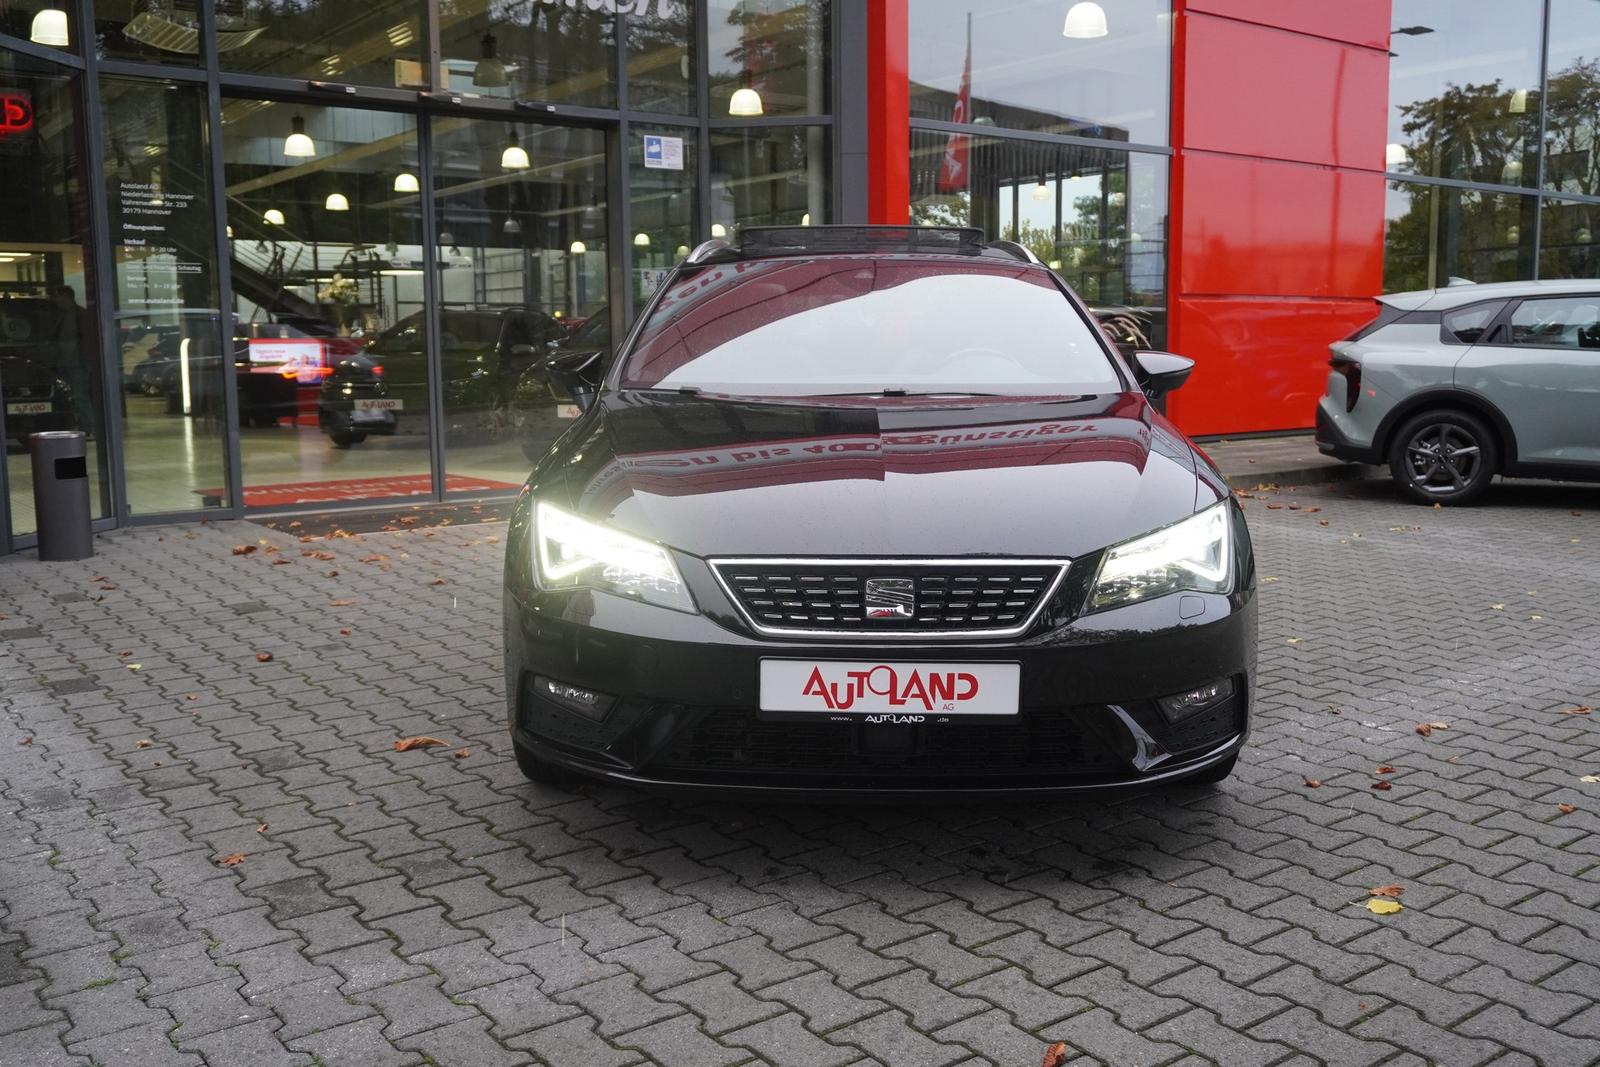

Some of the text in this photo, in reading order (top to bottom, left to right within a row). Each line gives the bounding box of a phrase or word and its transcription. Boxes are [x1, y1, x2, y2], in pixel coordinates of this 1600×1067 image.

[121, 191, 164, 200] Niederlassung
[802, 664, 979, 711] AUTOLAND
[942, 703, 955, 711] AG
[864, 713, 926, 724] AUTOLAND
